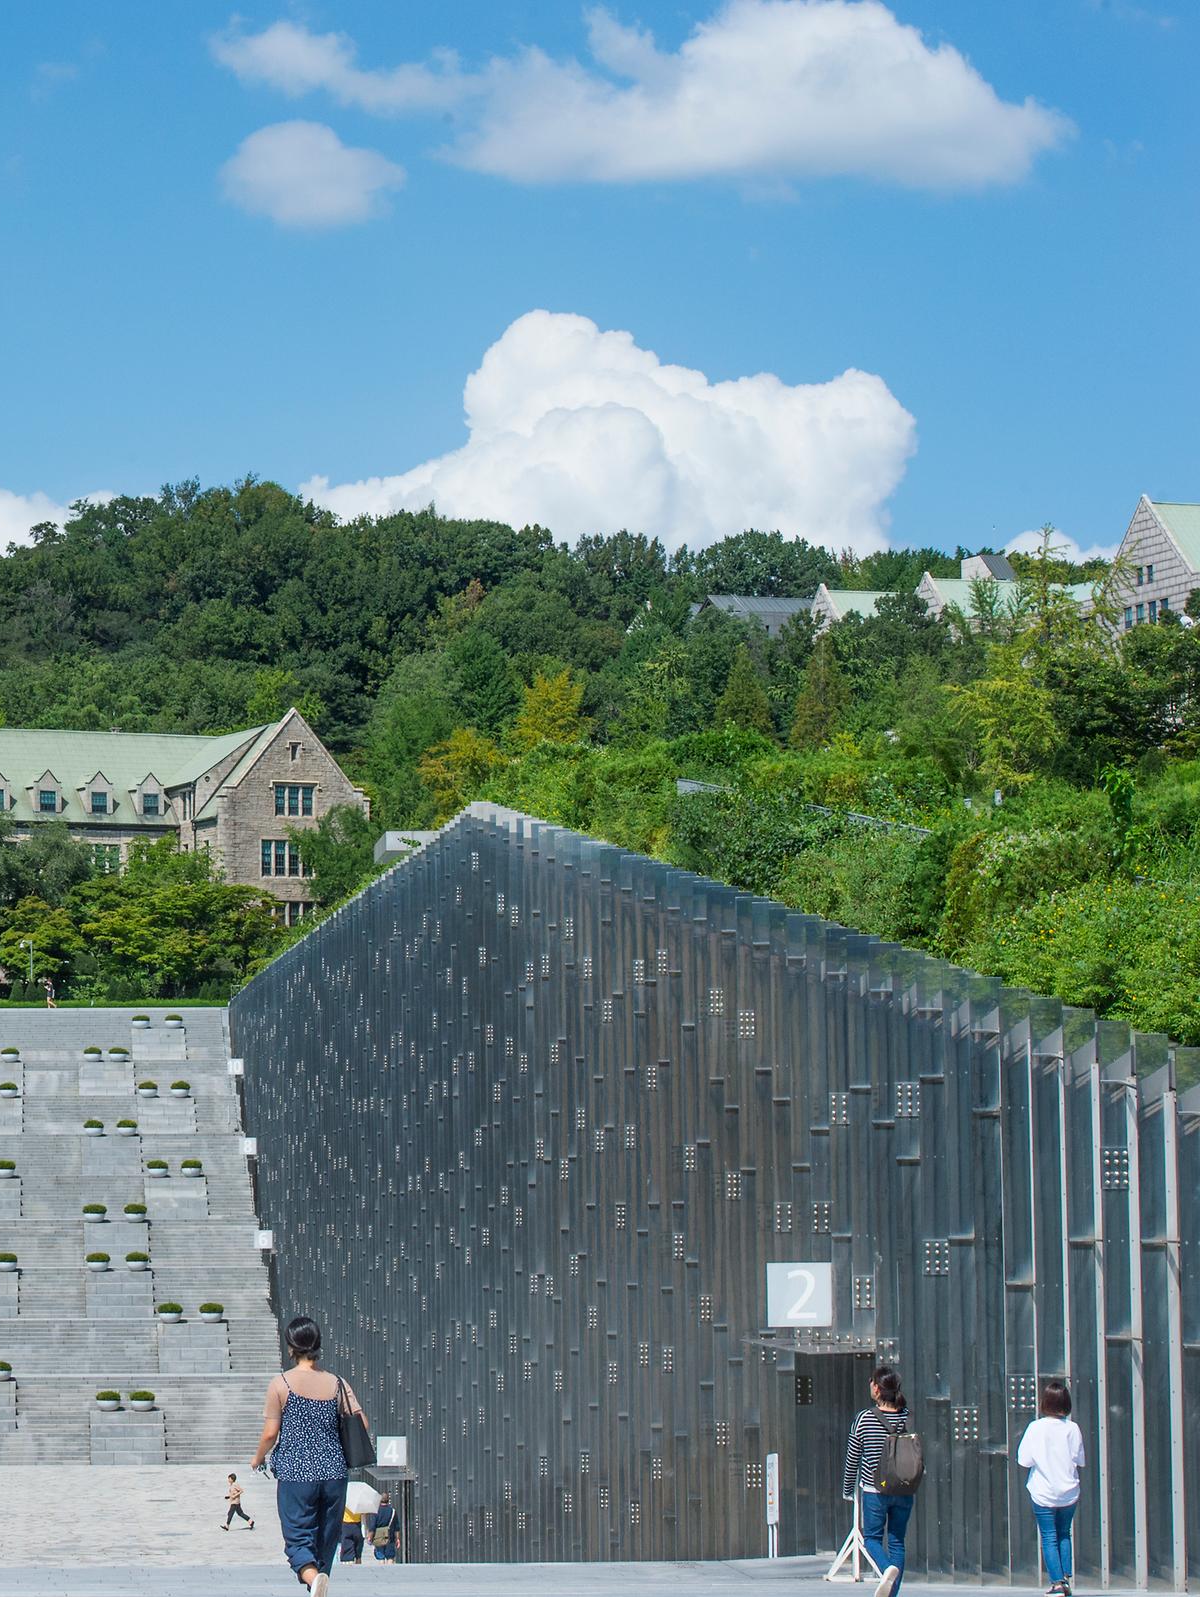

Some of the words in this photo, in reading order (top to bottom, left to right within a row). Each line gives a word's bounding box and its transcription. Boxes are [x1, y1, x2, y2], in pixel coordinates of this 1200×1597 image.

[228, 1060, 241, 1073] 10
[244, 1139, 252, 1153] 8
[259, 1231, 267, 1246] 6
[786, 1269, 817, 1319] 2
[383, 1439, 399, 1463] 4
